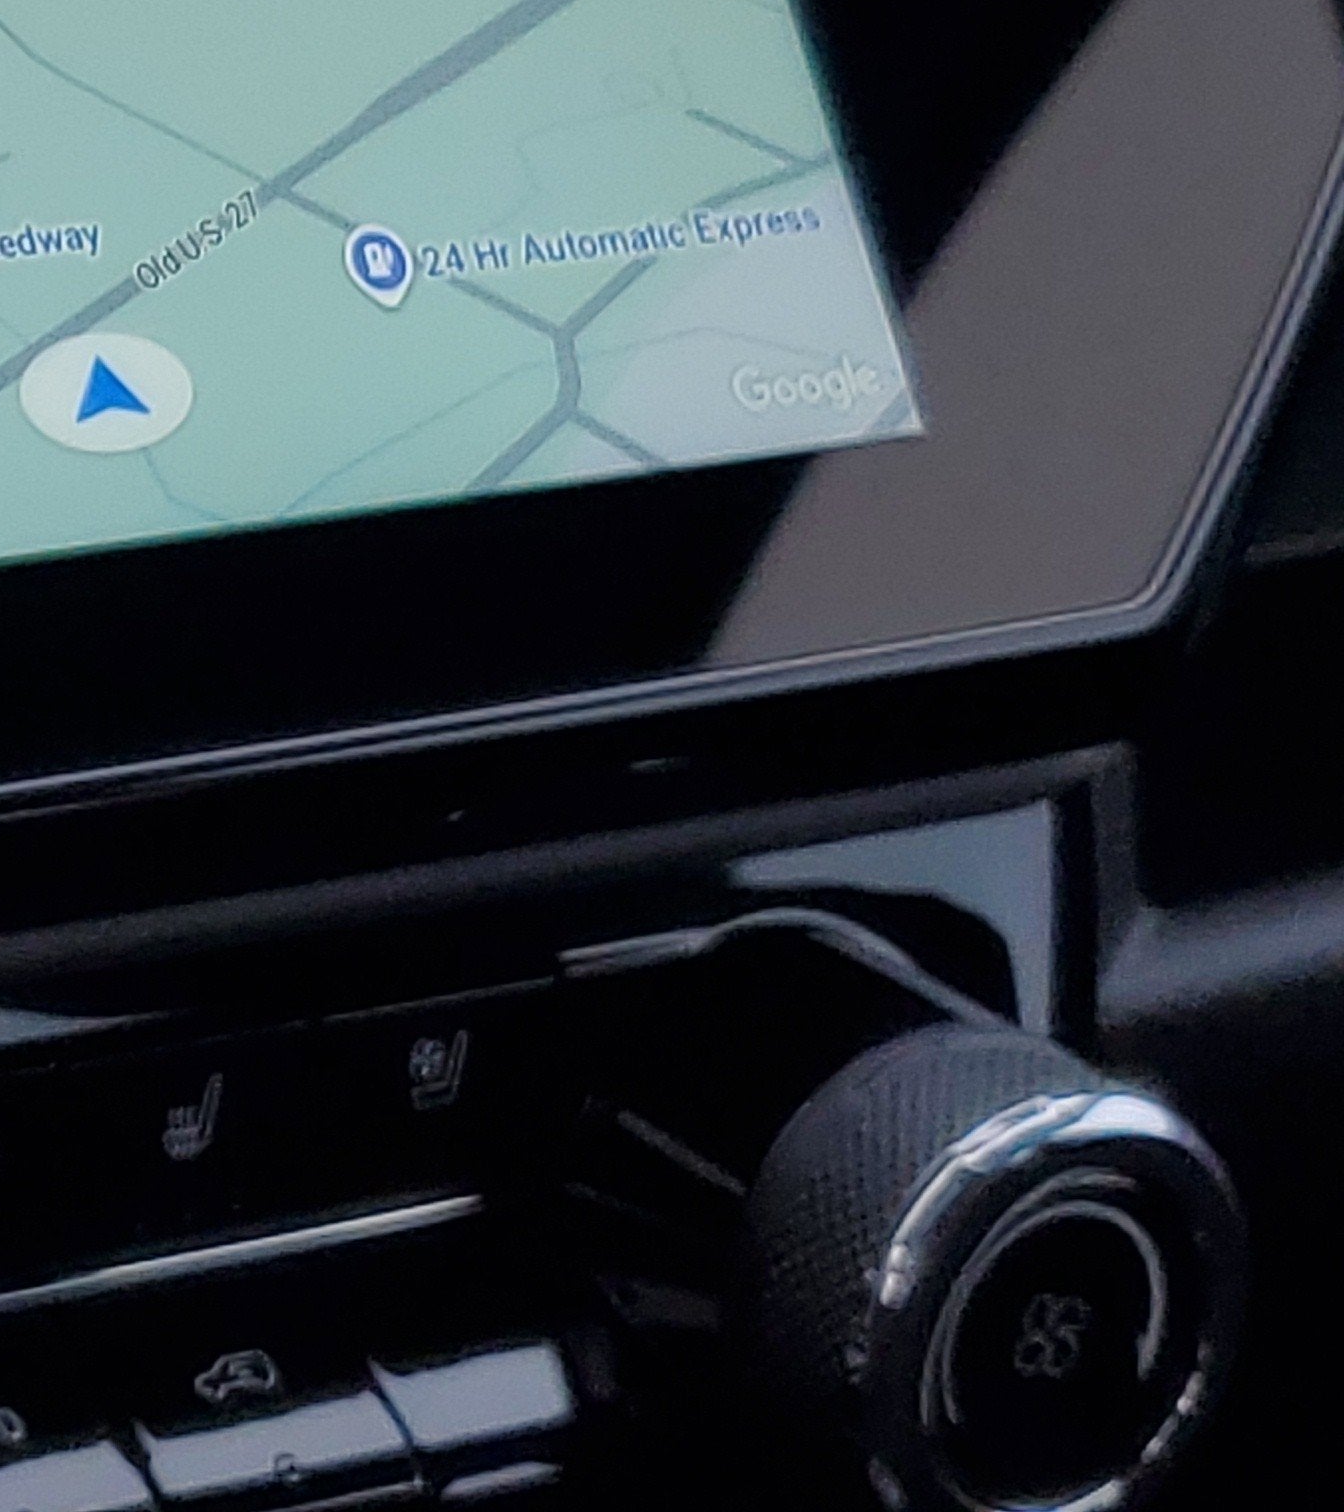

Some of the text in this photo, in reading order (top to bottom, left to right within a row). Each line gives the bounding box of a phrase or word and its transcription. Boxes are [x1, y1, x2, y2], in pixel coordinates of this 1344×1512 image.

[135, 245, 182, 289] Old
[224, 189, 257, 230] 27
[420, 206, 822, 278] 24 Hr Automatic Express
[731, 354, 884, 413] Google
